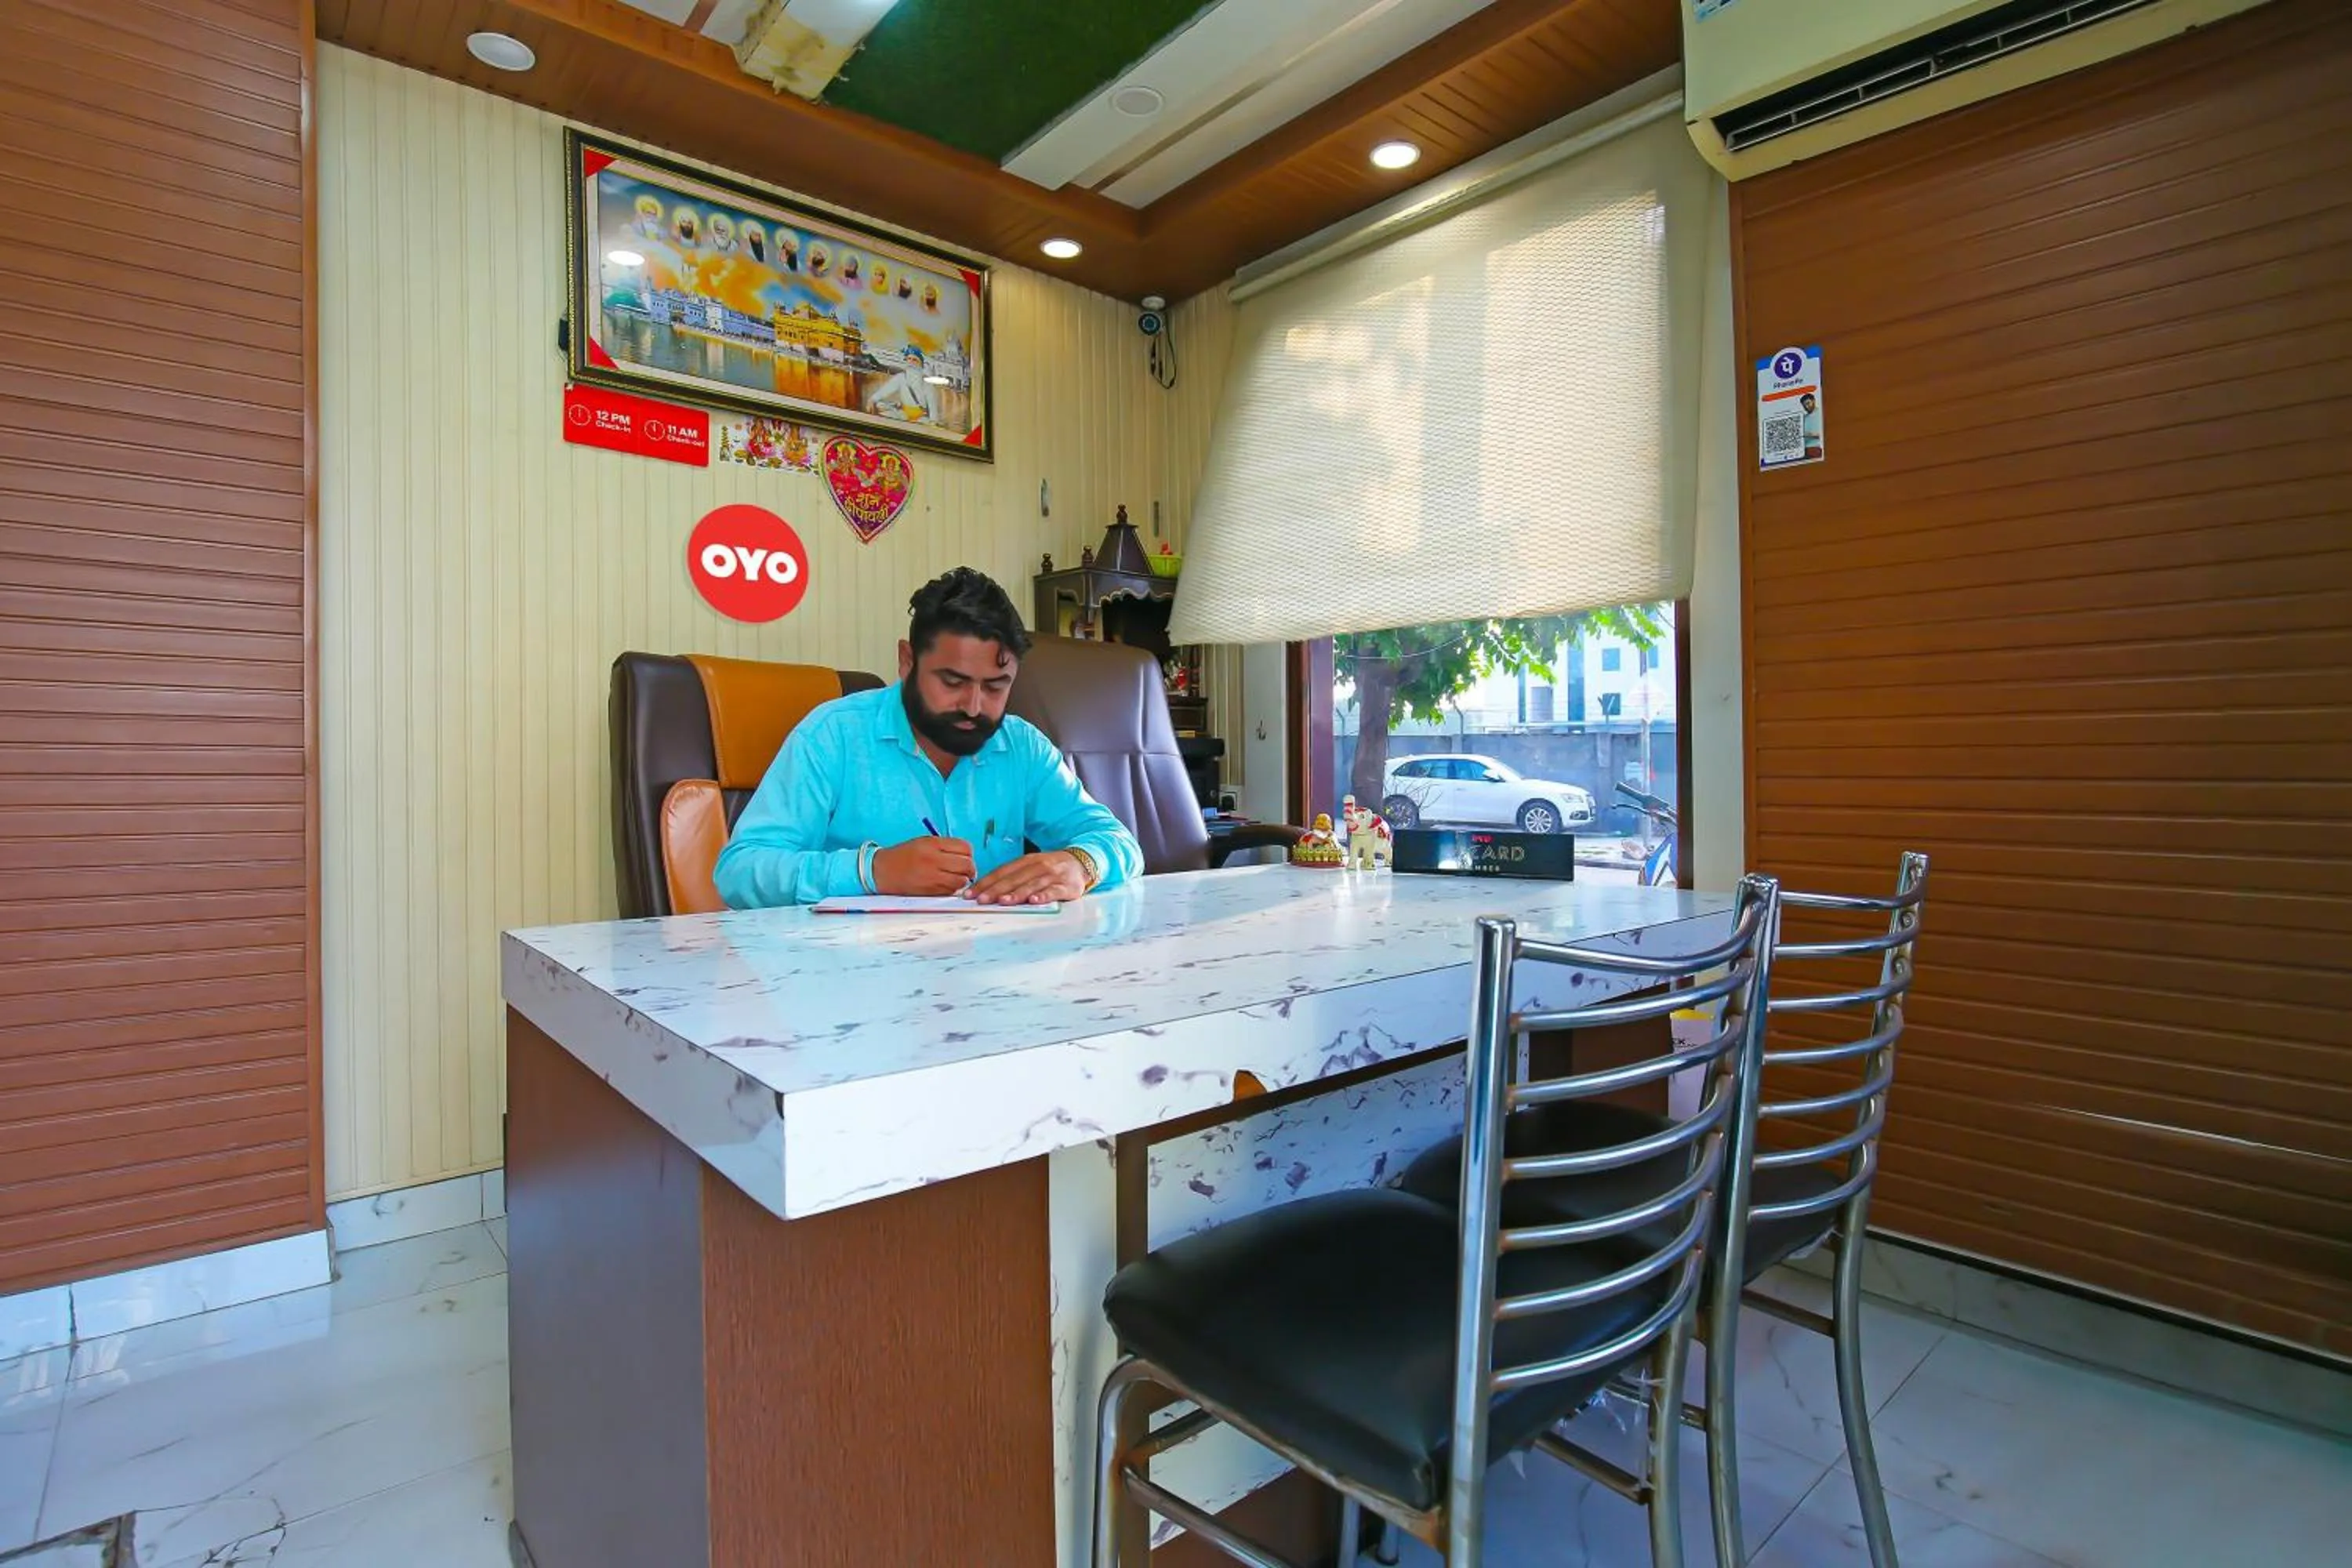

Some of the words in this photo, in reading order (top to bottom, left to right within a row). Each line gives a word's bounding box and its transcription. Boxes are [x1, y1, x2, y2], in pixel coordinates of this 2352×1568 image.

[595, 410, 609, 421] 12
[611, 413, 631, 425] PM
[595, 420, 632, 434] Check-in
[667, 424, 677, 434] 11
[679, 427, 699, 438] AM
[701, 543, 798, 584] OYO
